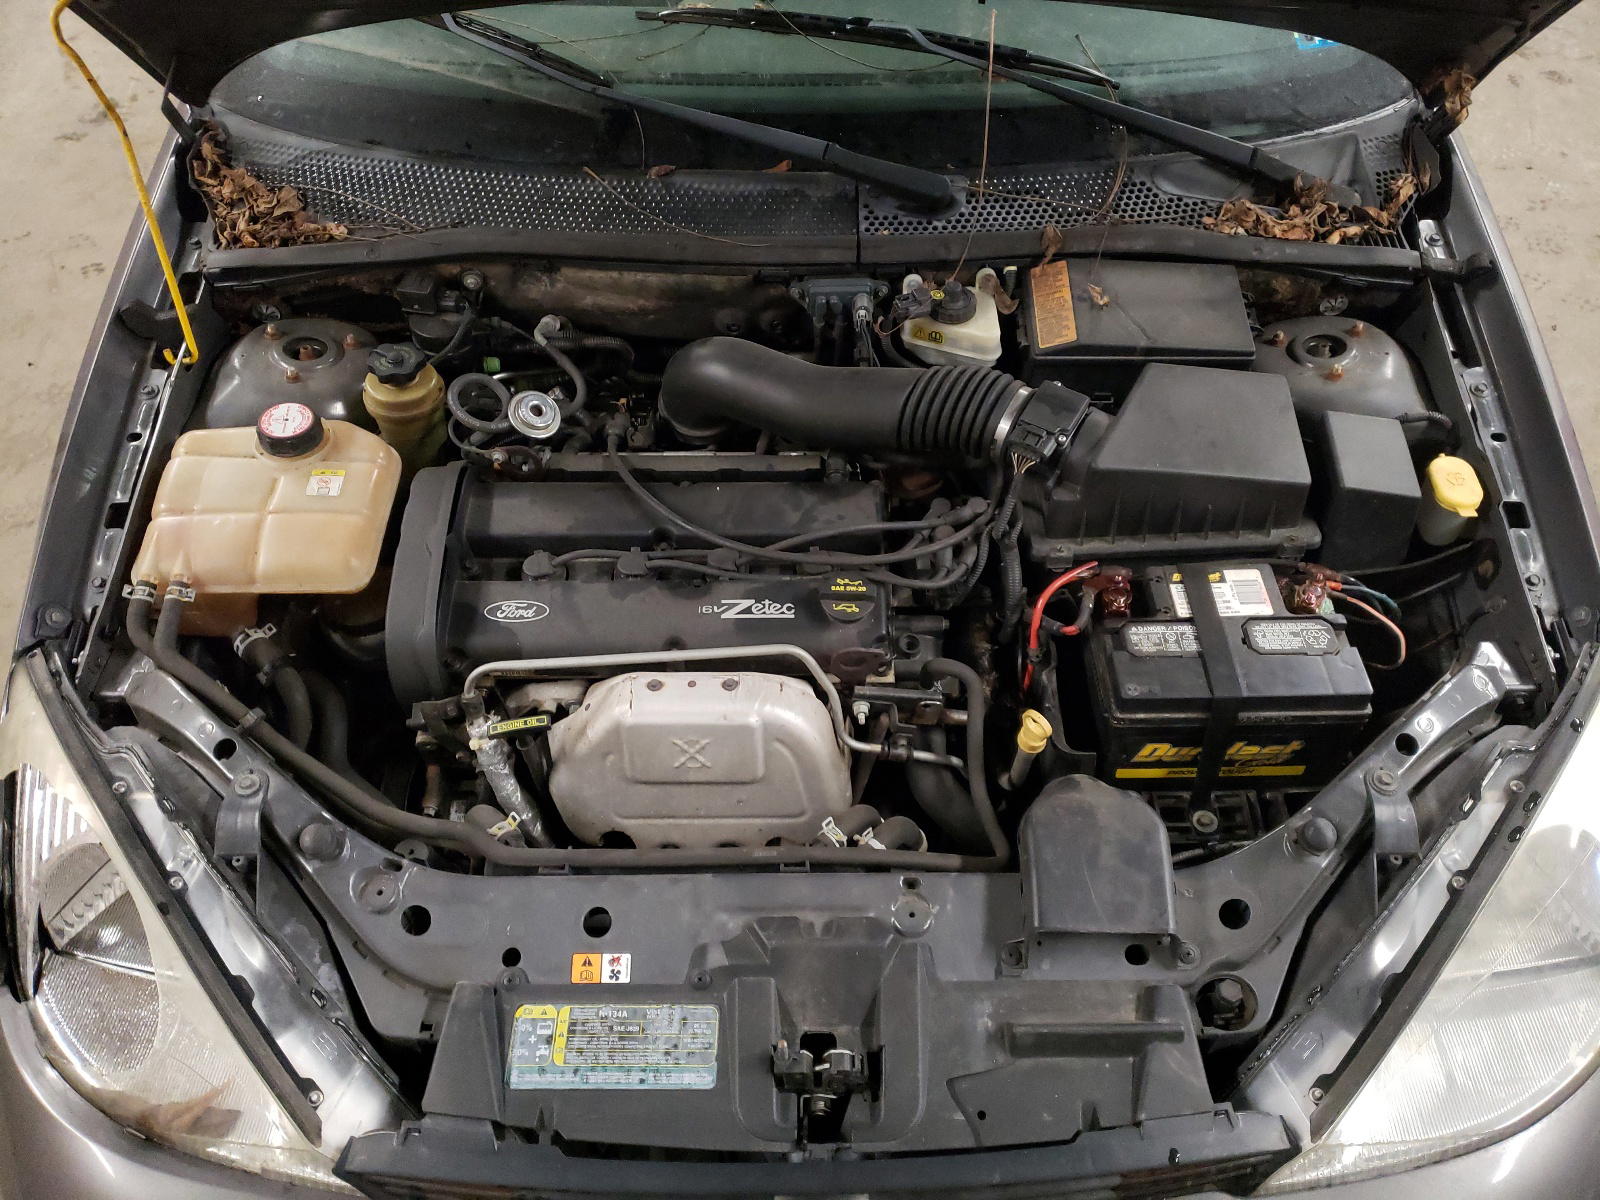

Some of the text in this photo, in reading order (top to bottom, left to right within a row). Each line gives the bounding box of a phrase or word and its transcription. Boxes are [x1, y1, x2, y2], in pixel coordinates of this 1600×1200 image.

[497, 603, 537, 617] Ford
[720, 599, 796, 619] Zetec
[498, 720, 525, 731] ENGINE
